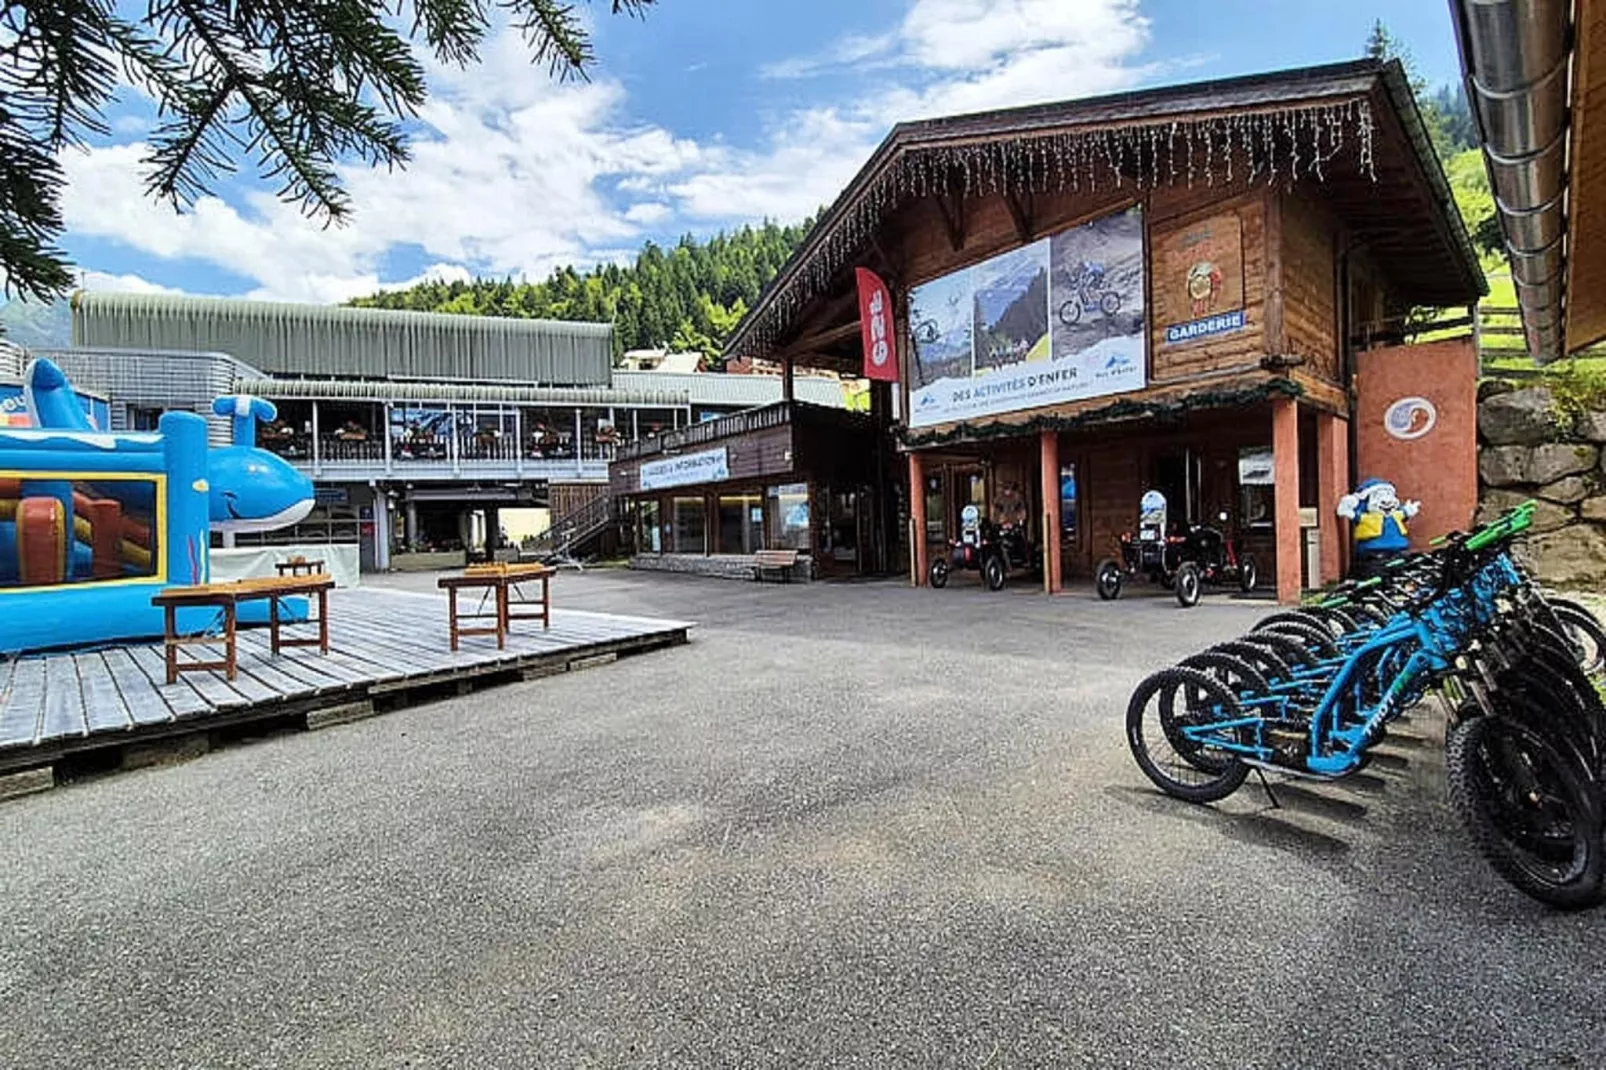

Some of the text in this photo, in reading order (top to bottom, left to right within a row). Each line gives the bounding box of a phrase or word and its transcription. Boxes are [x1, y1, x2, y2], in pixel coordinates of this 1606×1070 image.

[1169, 314, 1242, 340] GARDERIE
[953, 388, 971, 403] DES
[1027, 366, 1078, 388] D'ENFER
